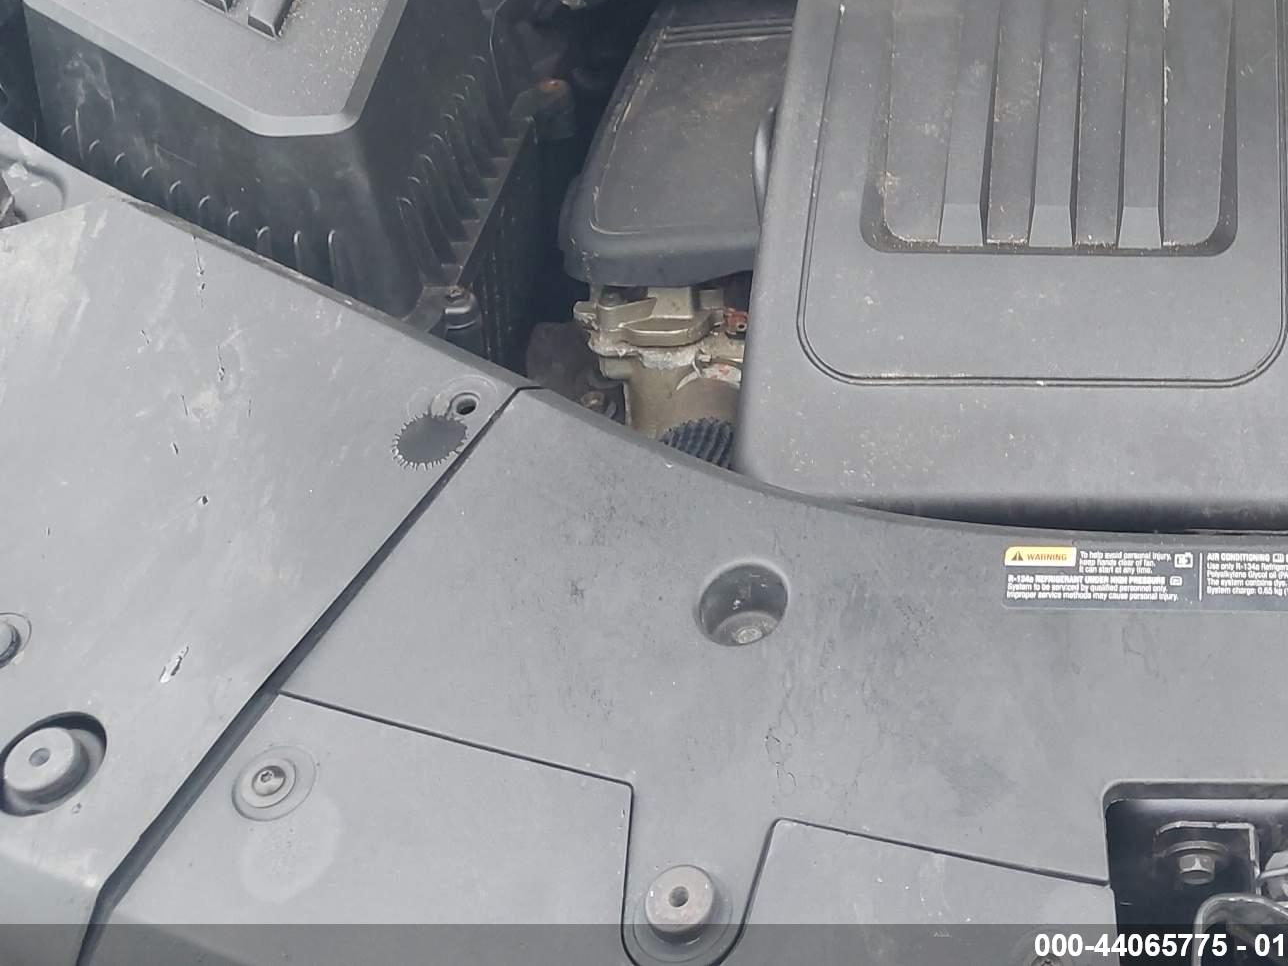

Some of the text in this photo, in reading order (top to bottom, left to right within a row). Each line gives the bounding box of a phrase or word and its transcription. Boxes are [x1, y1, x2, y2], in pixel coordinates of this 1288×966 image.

[1027, 553, 1068, 561] WARNING
[1207, 553, 1270, 562] AIR CONDITIONING
[1207, 562, 1219, 570] Use
[1220, 563, 1234, 571] only
[1236, 563, 1260, 571] R-134a
[1007, 583, 1032, 592] System
[1063, 592, 1091, 600] methods
[1092, 592, 1108, 601] may
